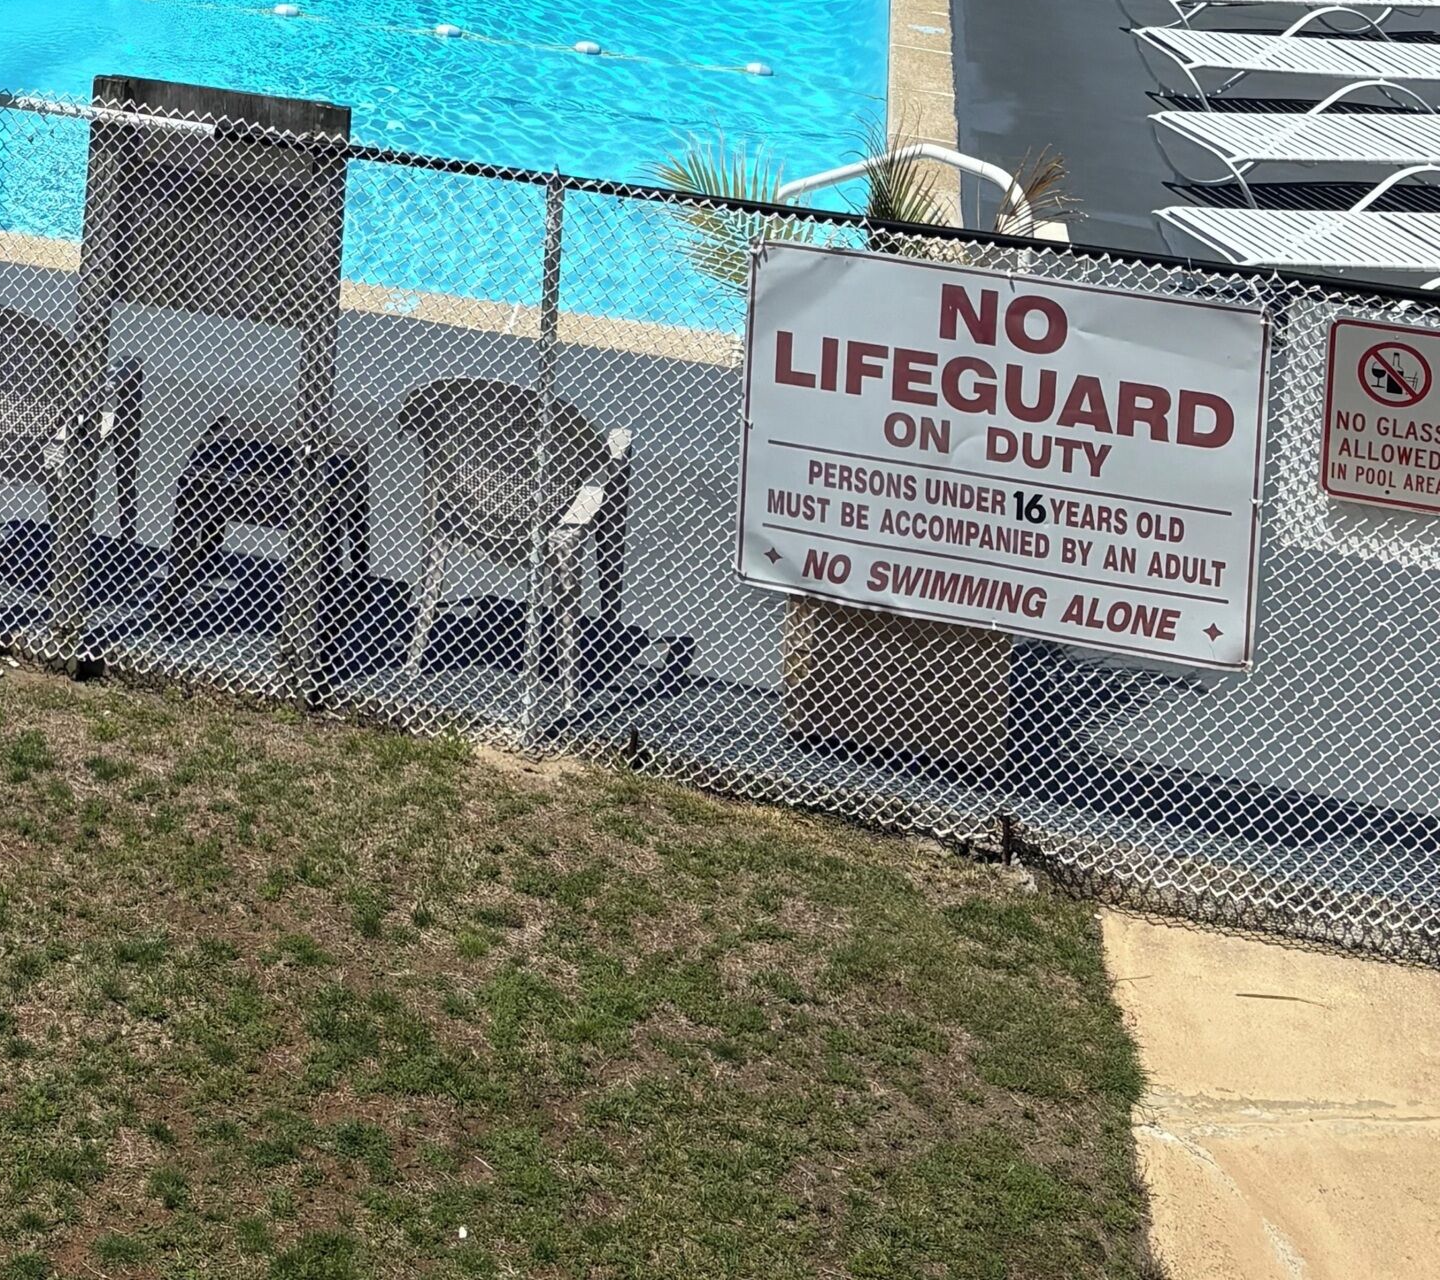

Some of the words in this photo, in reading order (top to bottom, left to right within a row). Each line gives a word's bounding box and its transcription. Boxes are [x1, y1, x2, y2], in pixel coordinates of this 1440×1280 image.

[939, 283, 1068, 355] NO
[775, 330, 1235, 449] LIFEGUARD
[1336, 409, 1366, 433] NO
[884, 412, 950, 454] ON
[986, 426, 1112, 478] DUTY
[1331, 462, 1347, 481] IN
[1355, 466, 1396, 488] POOL
[1338, 437, 1440, 471] ALLOWED
[808, 459, 917, 501] PERSONS
[925, 478, 1006, 516] UNDER
[1013, 490, 1047, 524] 16
[1049, 497, 1128, 536] YEARS
[1136, 511, 1185, 543] OLD
[767, 488, 831, 523] MUST
[840, 501, 870, 530] BE
[879, 508, 1050, 559] ACCOMPANIED
[1061, 537, 1093, 567] BY
[1103, 544, 1137, 574] AN
[1147, 551, 1226, 587] ADULT
[802, 549, 852, 585] NO
[866, 561, 1048, 619] SWIMMING
[1060, 594, 1181, 642] ALONE
